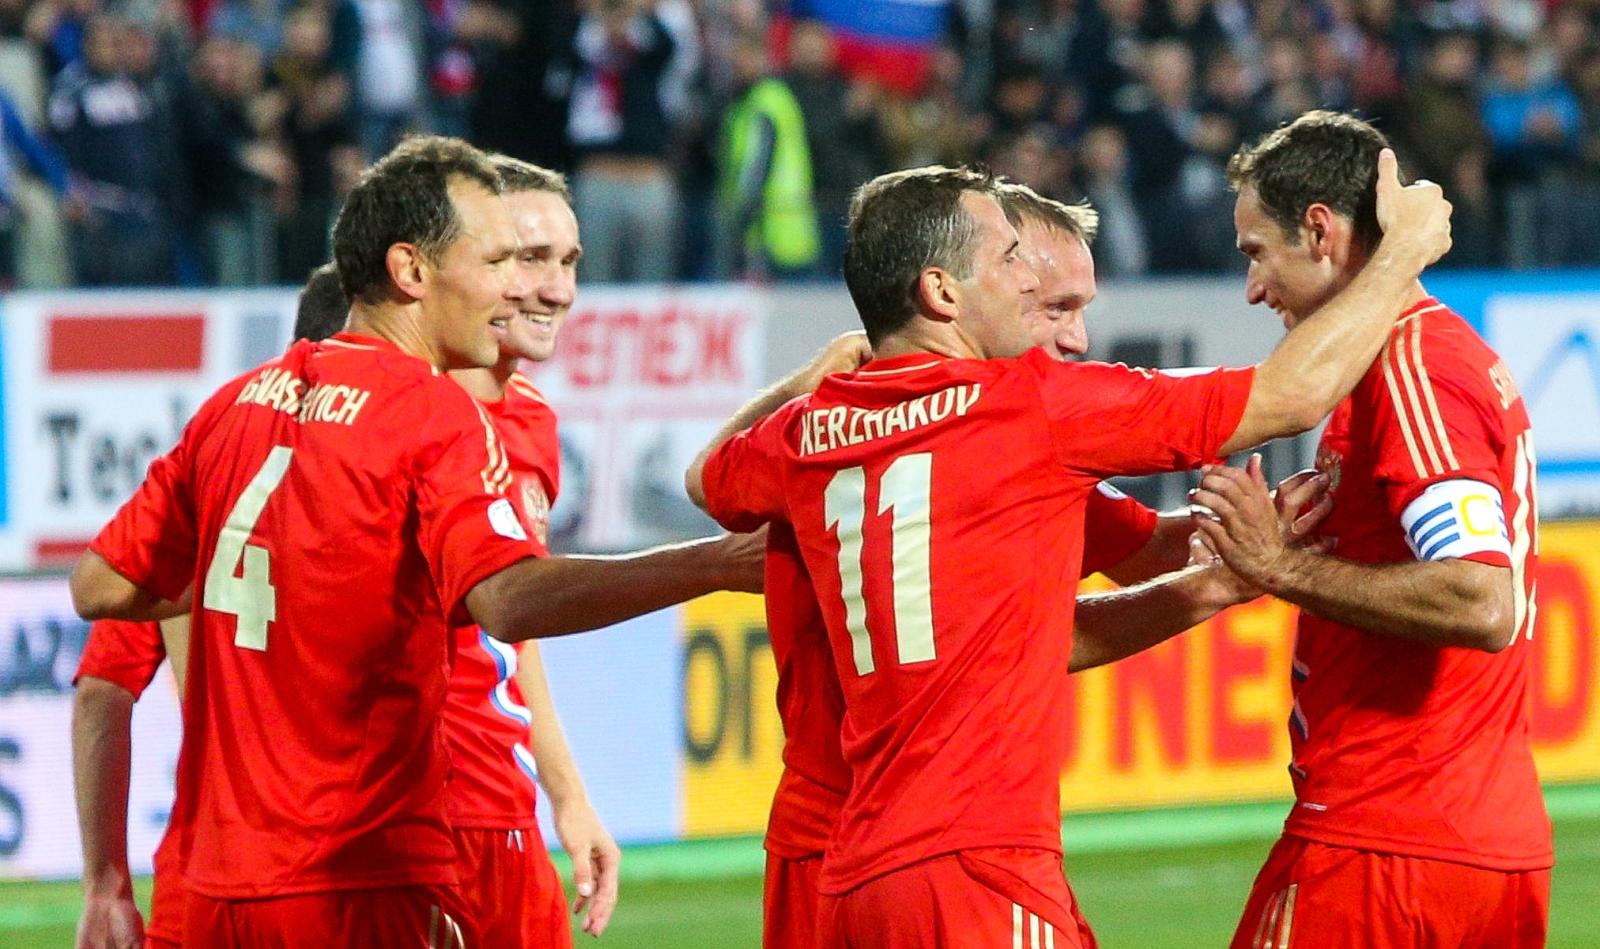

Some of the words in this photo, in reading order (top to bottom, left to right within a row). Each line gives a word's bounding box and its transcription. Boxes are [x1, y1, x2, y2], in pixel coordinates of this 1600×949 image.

[800, 382, 982, 458] KERZHAKOV
[203, 444, 294, 652] 4
[823, 452, 937, 677] 11
[1459, 494, 1498, 537] C
[1056, 592, 1278, 774] NE
